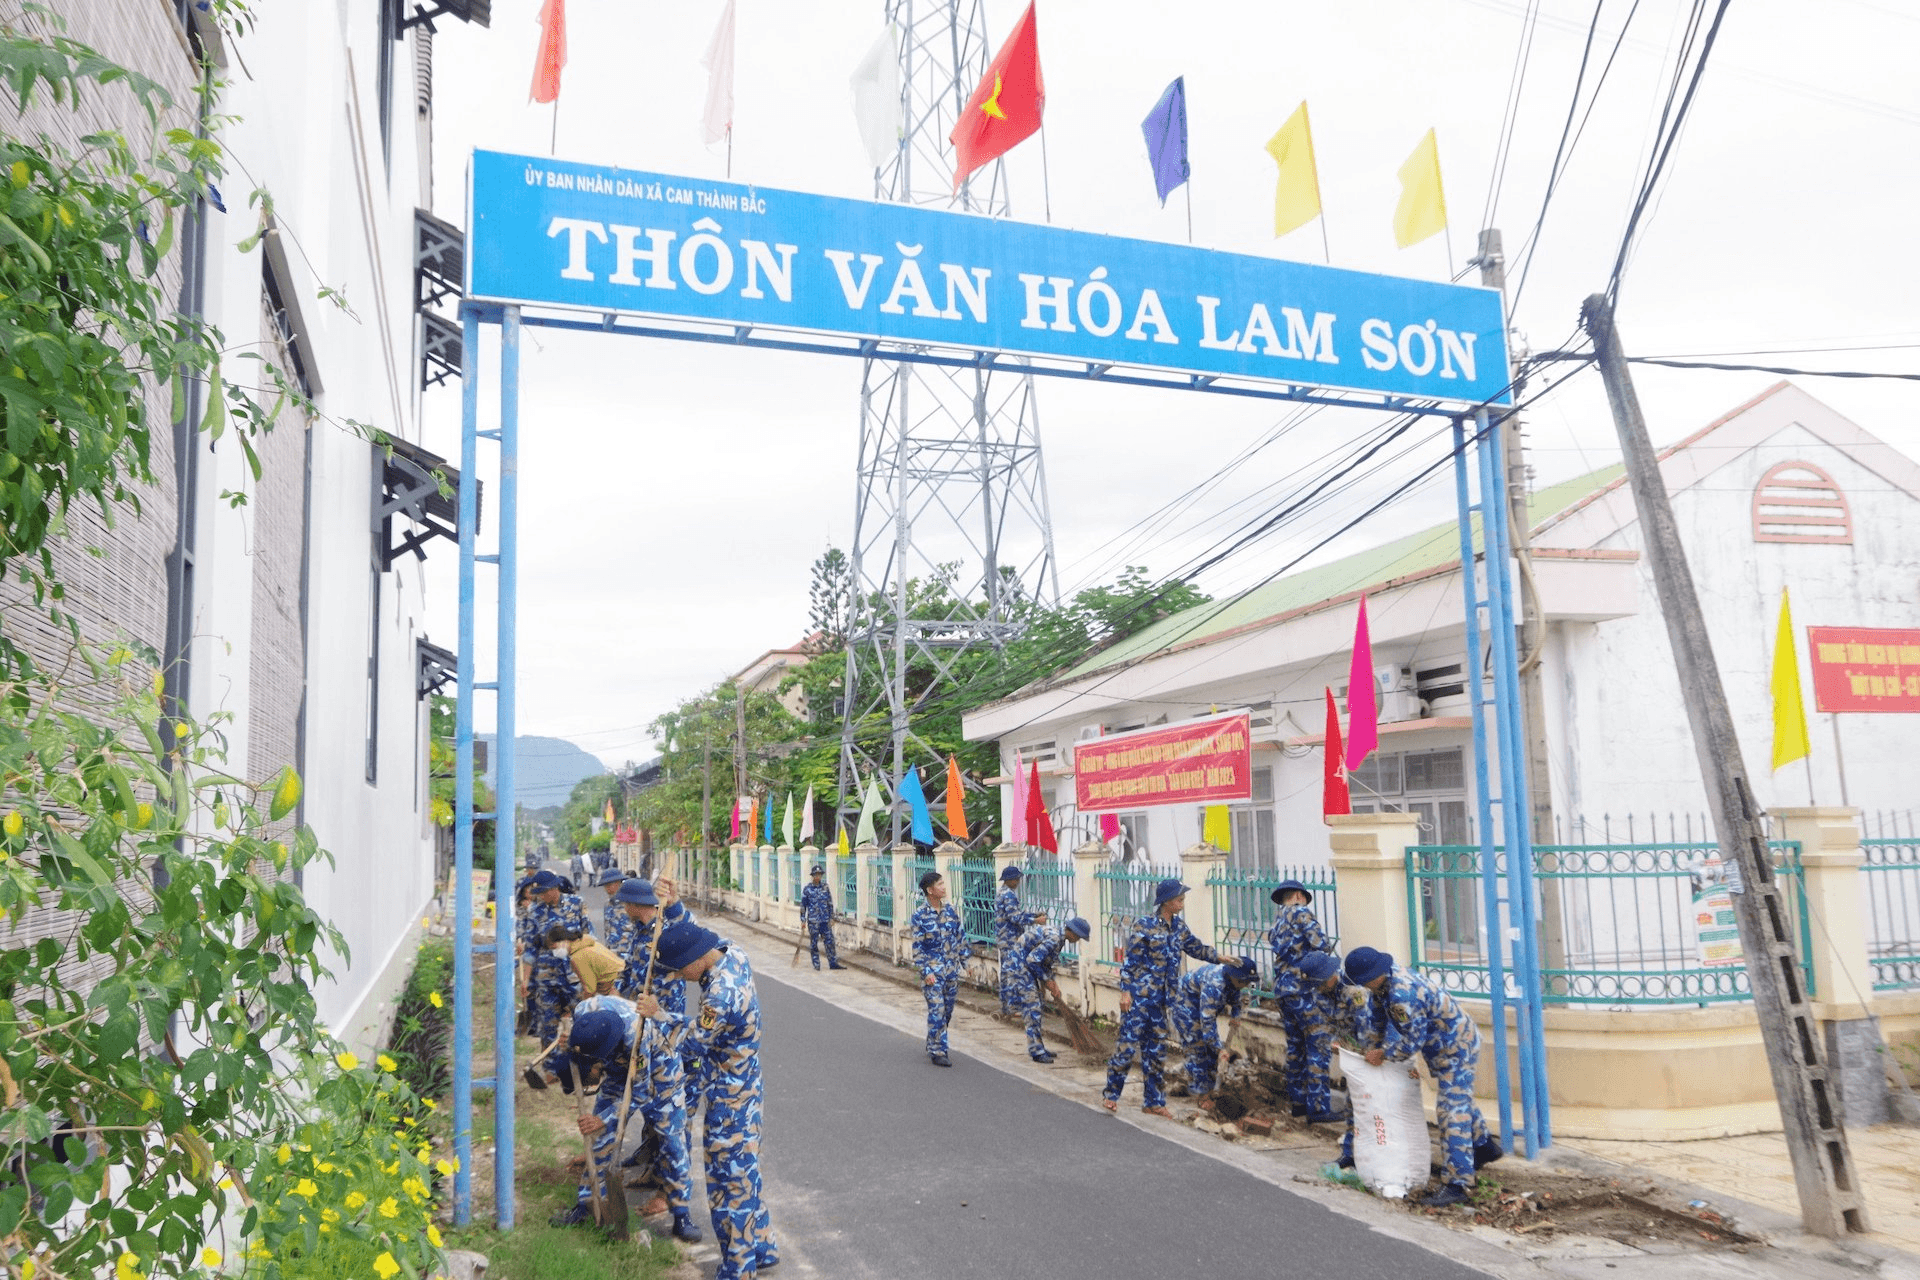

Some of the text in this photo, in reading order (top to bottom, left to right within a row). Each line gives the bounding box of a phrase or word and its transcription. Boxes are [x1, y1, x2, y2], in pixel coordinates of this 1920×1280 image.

[525, 163, 766, 215] ỦY BAN NHÂN DÂN XÃ CAM THÀNH BẮC
[547, 217, 1476, 381] THÔN VĂN HÓA LAM SƠN
